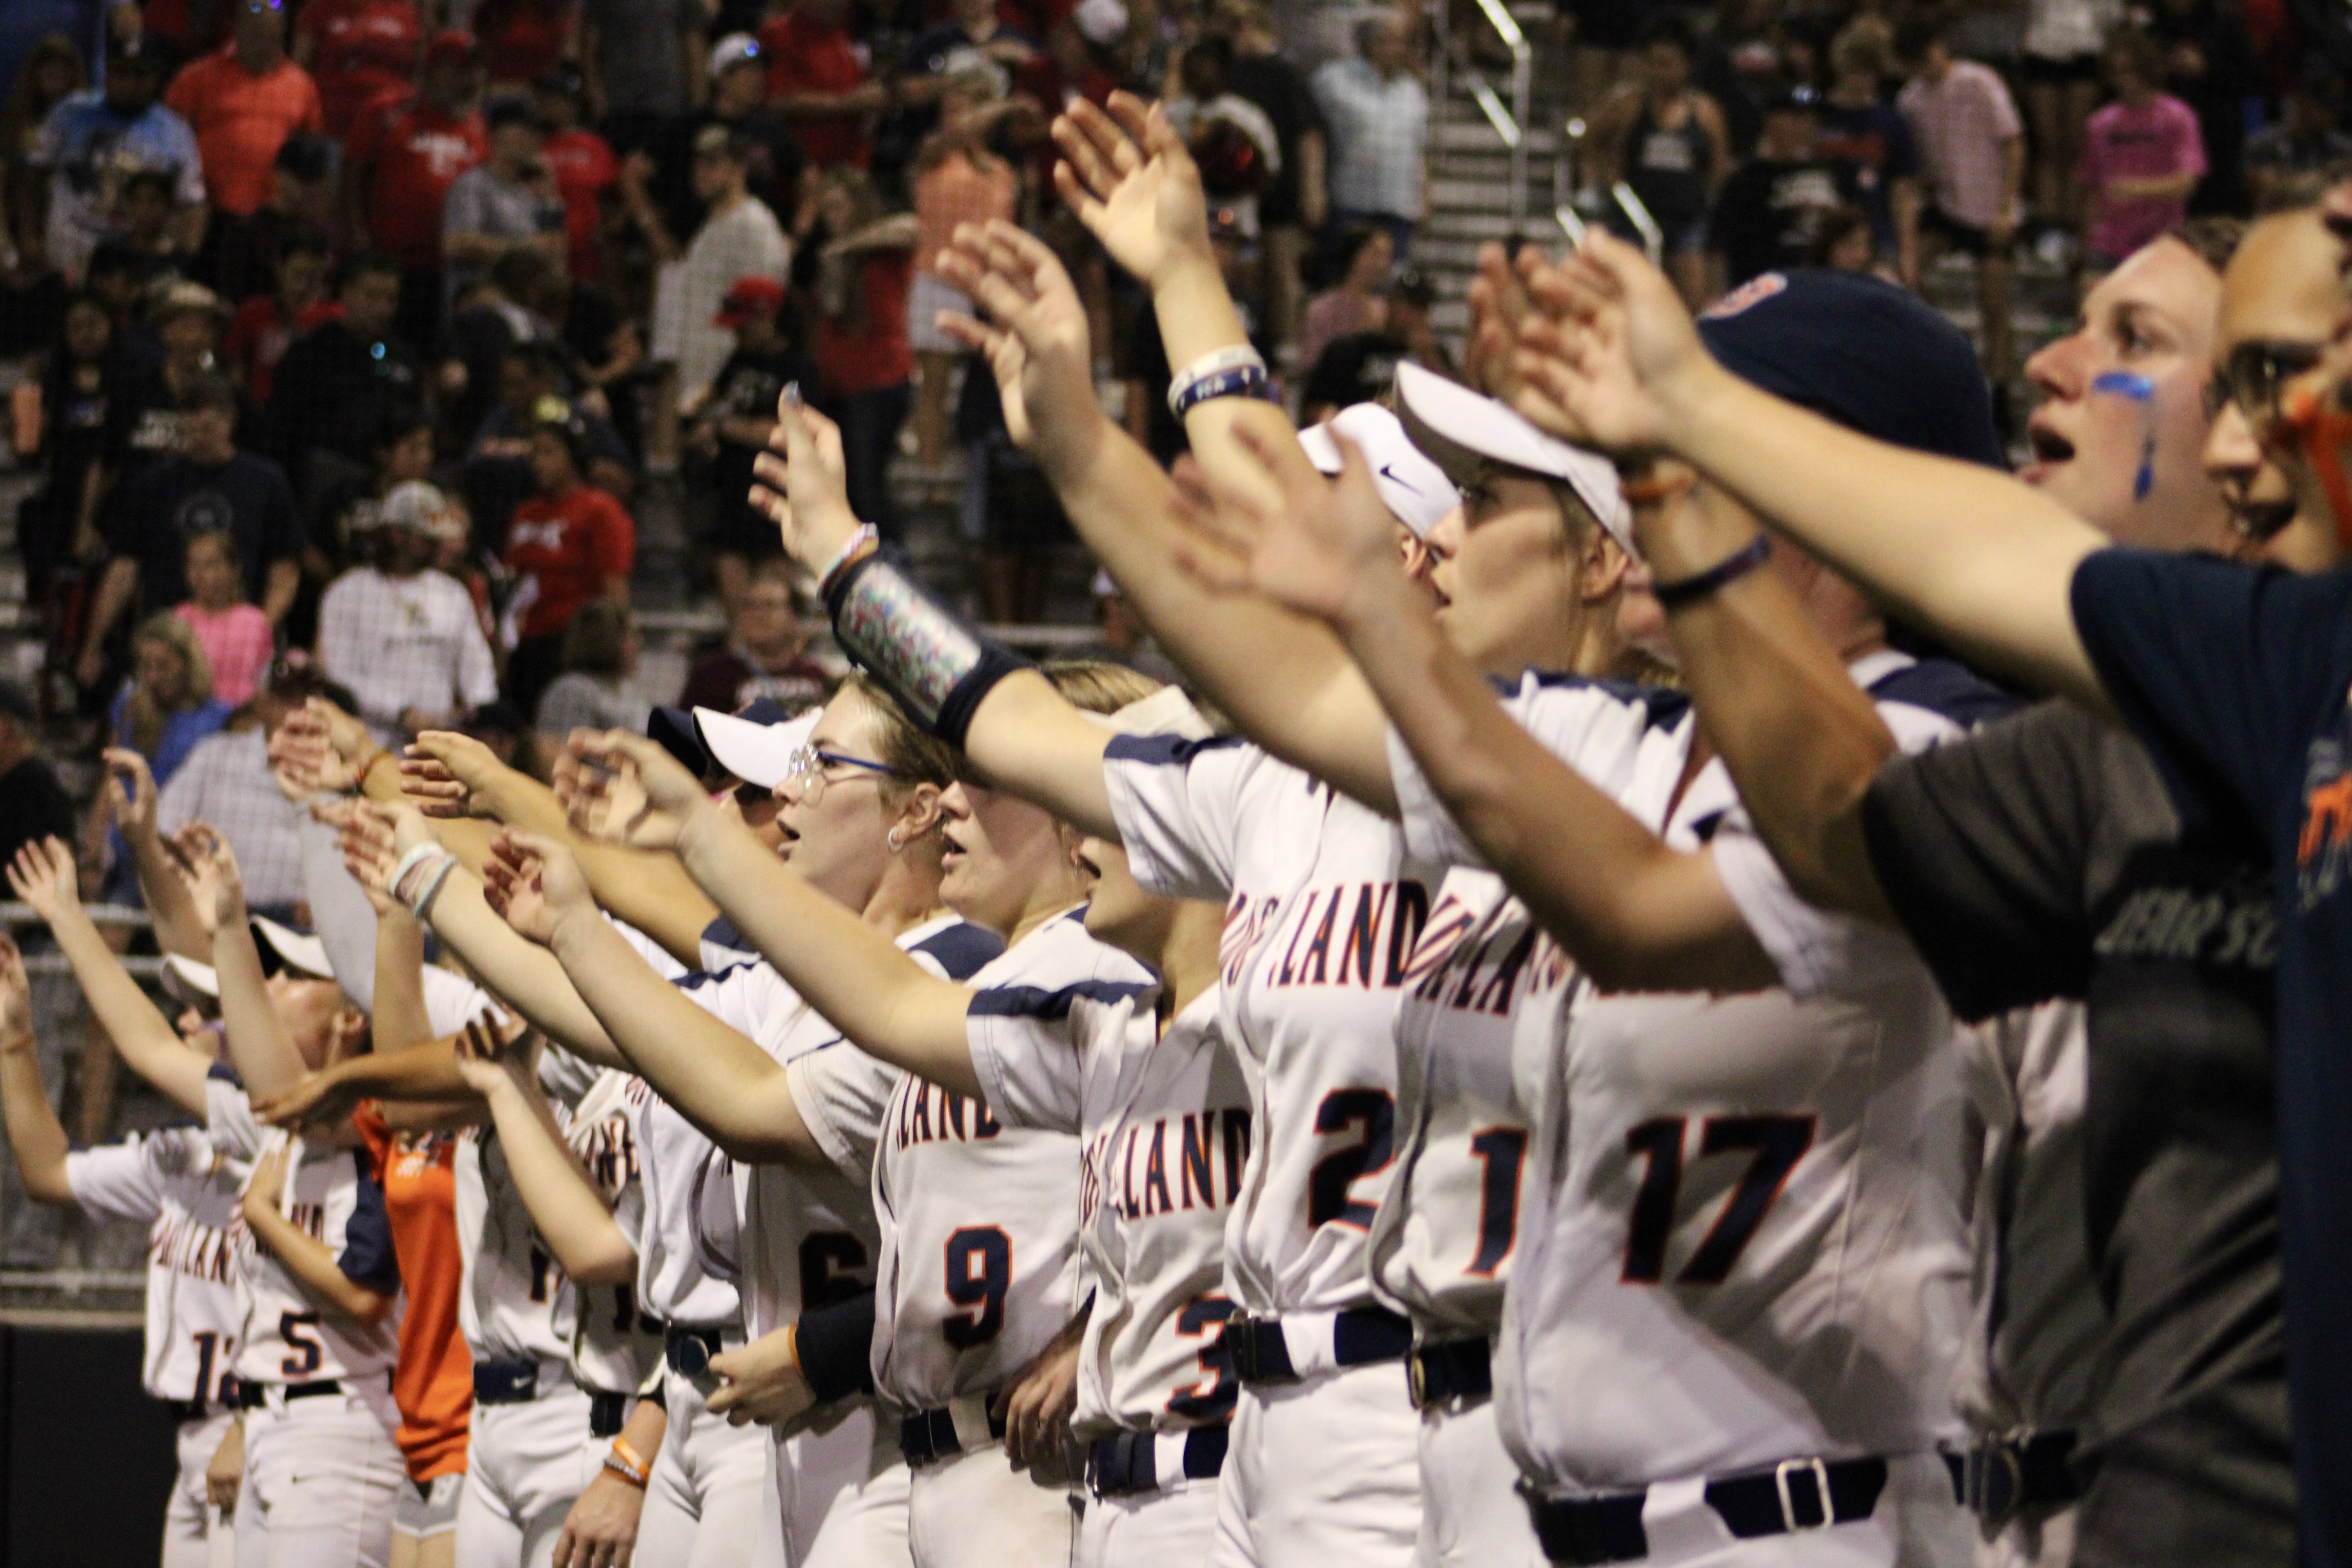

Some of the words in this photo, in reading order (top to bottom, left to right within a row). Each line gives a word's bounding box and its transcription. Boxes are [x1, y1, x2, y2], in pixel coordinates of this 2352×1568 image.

[1307, 1087, 1396, 1233] 2
[1618, 1112, 1819, 1285] 17
[279, 1308, 323, 1380] 5
[943, 1225, 1013, 1350] 9
[1163, 1294, 1240, 1422] 3
